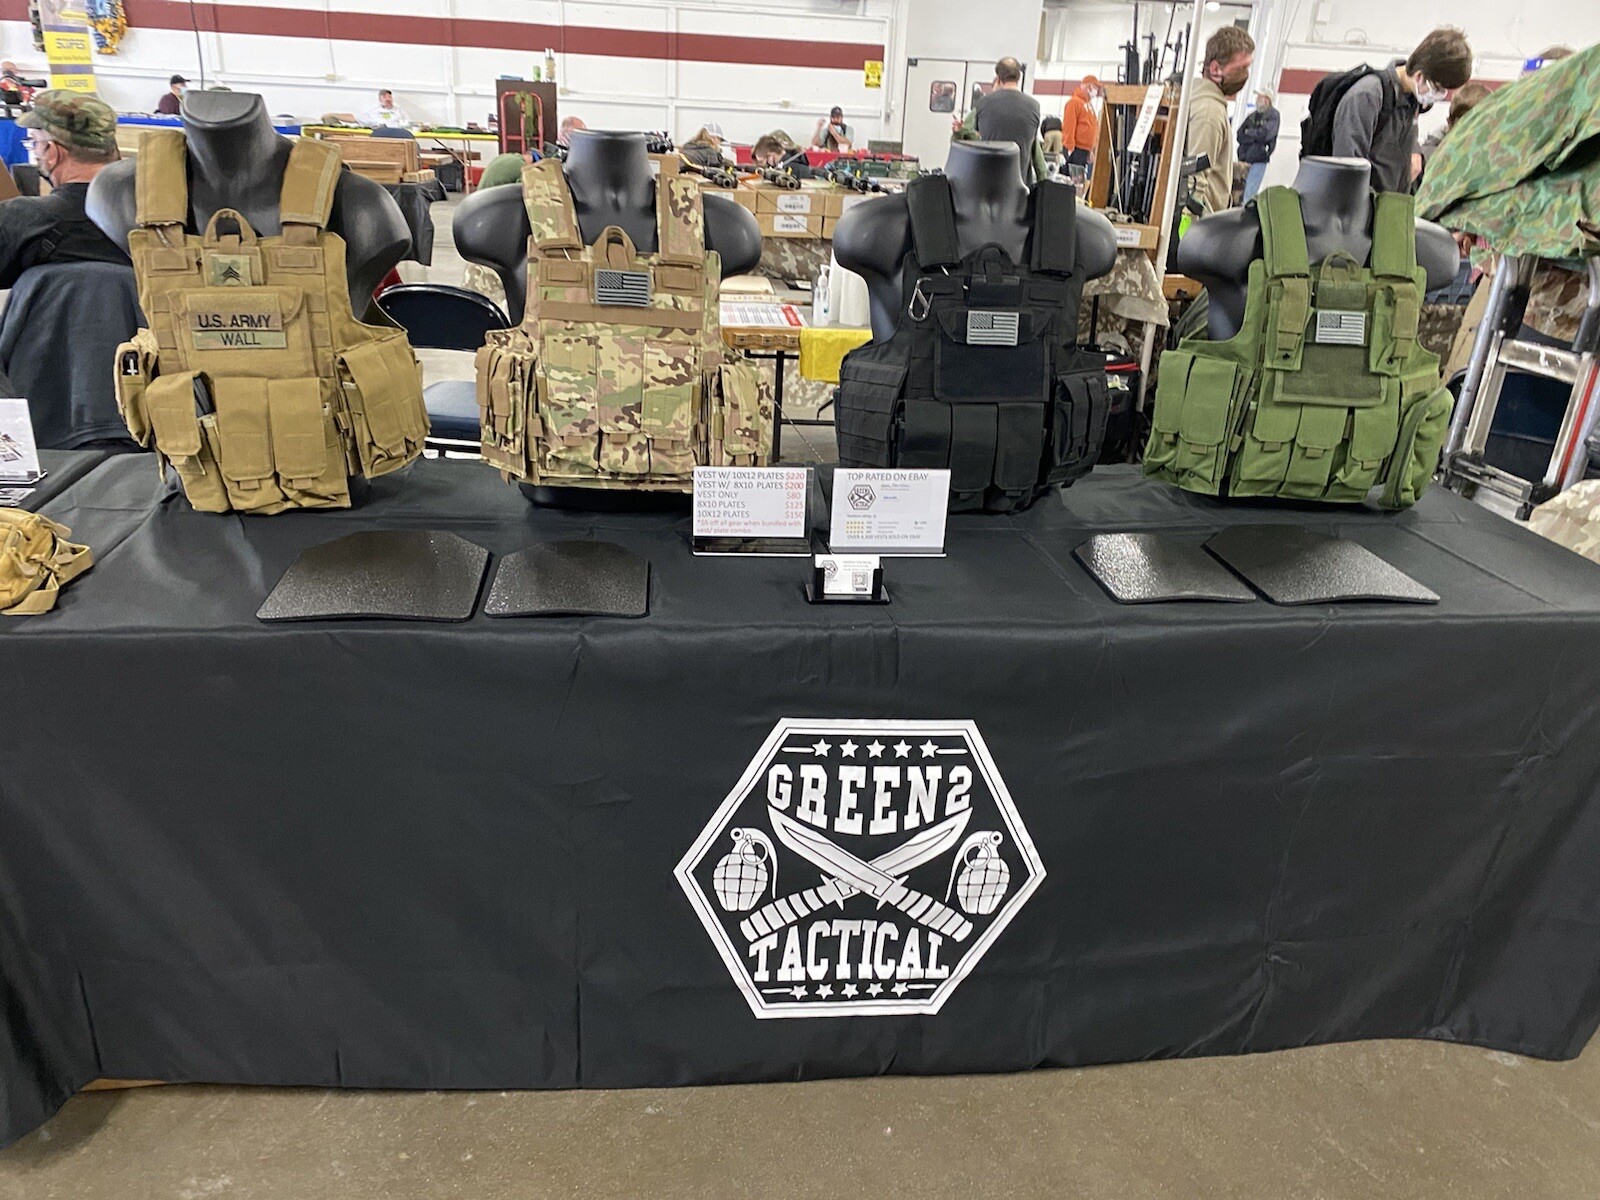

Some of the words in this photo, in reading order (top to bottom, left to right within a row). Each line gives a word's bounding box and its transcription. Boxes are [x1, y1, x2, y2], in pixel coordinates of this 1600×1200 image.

[198, 314, 226, 328] U.S.
[230, 314, 270, 328] ARMY
[220, 332, 260, 346] WALL
[719, 471, 730, 479] W/
[786, 472, 804, 480] $220
[748, 919, 950, 982] TACTICAL
